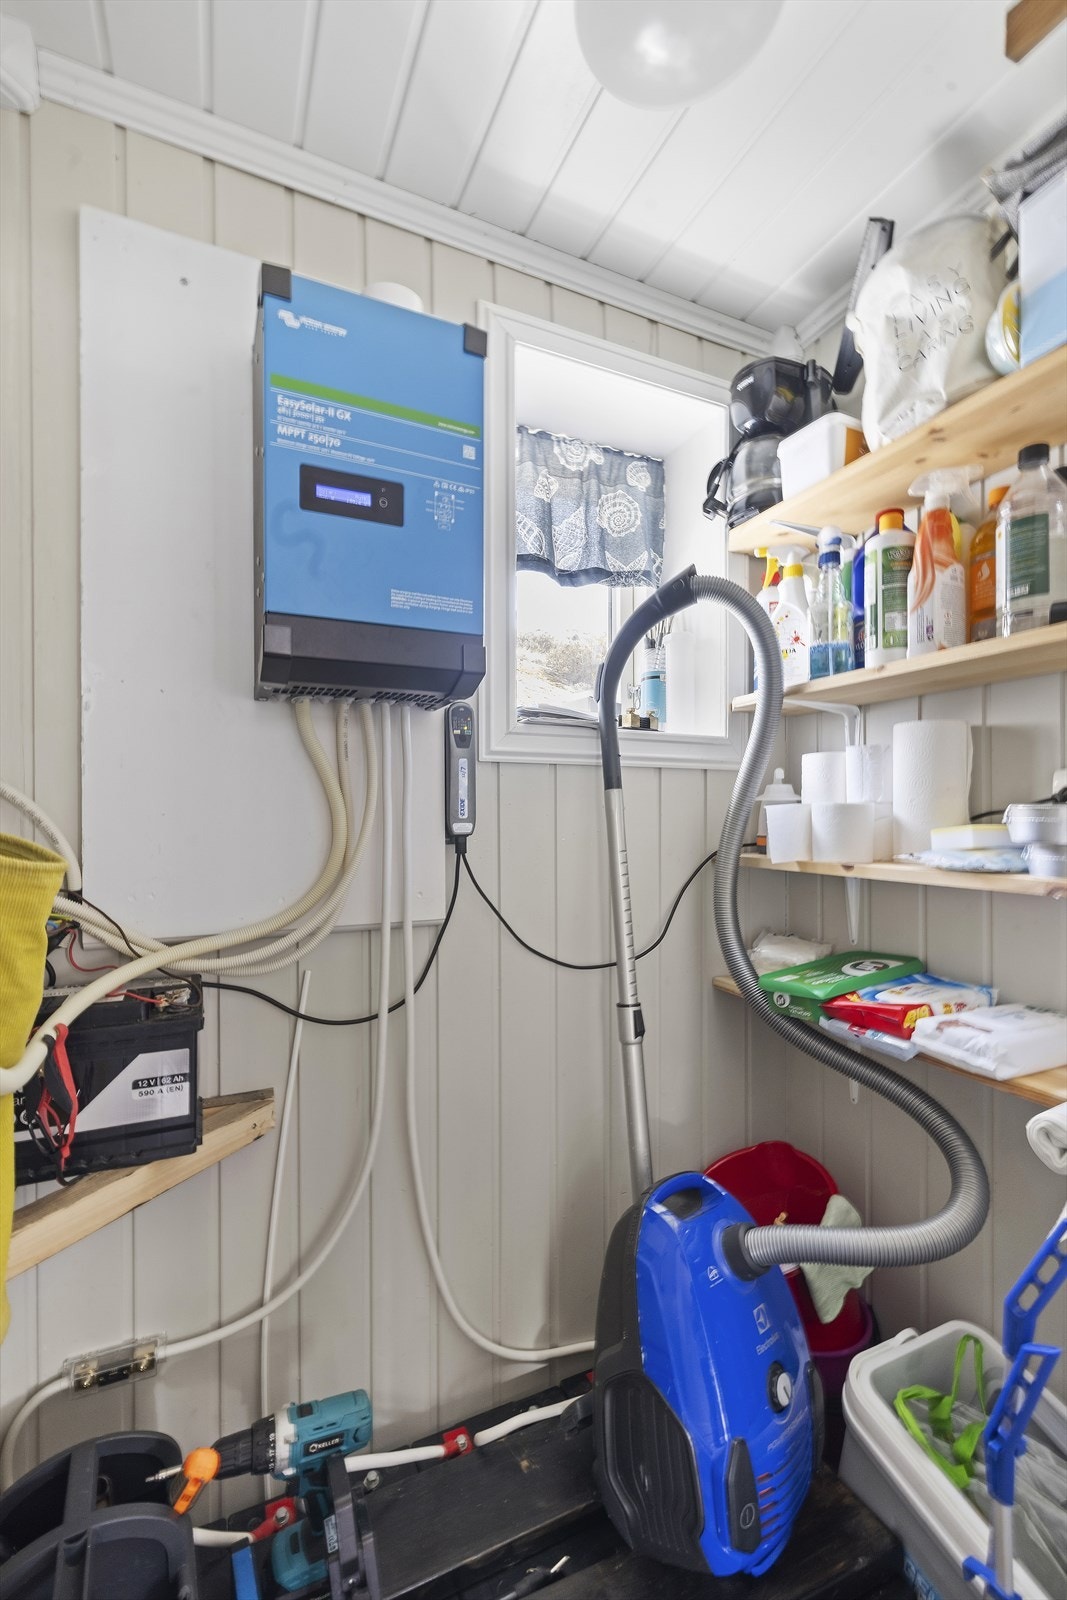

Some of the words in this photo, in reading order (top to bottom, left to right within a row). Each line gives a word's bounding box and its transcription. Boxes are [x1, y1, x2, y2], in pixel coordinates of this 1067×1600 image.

[276, 424, 306, 440] MPPT
[138, 1080, 148, 1088] 12
[150, 1078, 156, 1086] V
[161, 1076, 172, 1084] 62
[173, 1075, 184, 1083] Ah
[138, 1089, 155, 1098] 590
